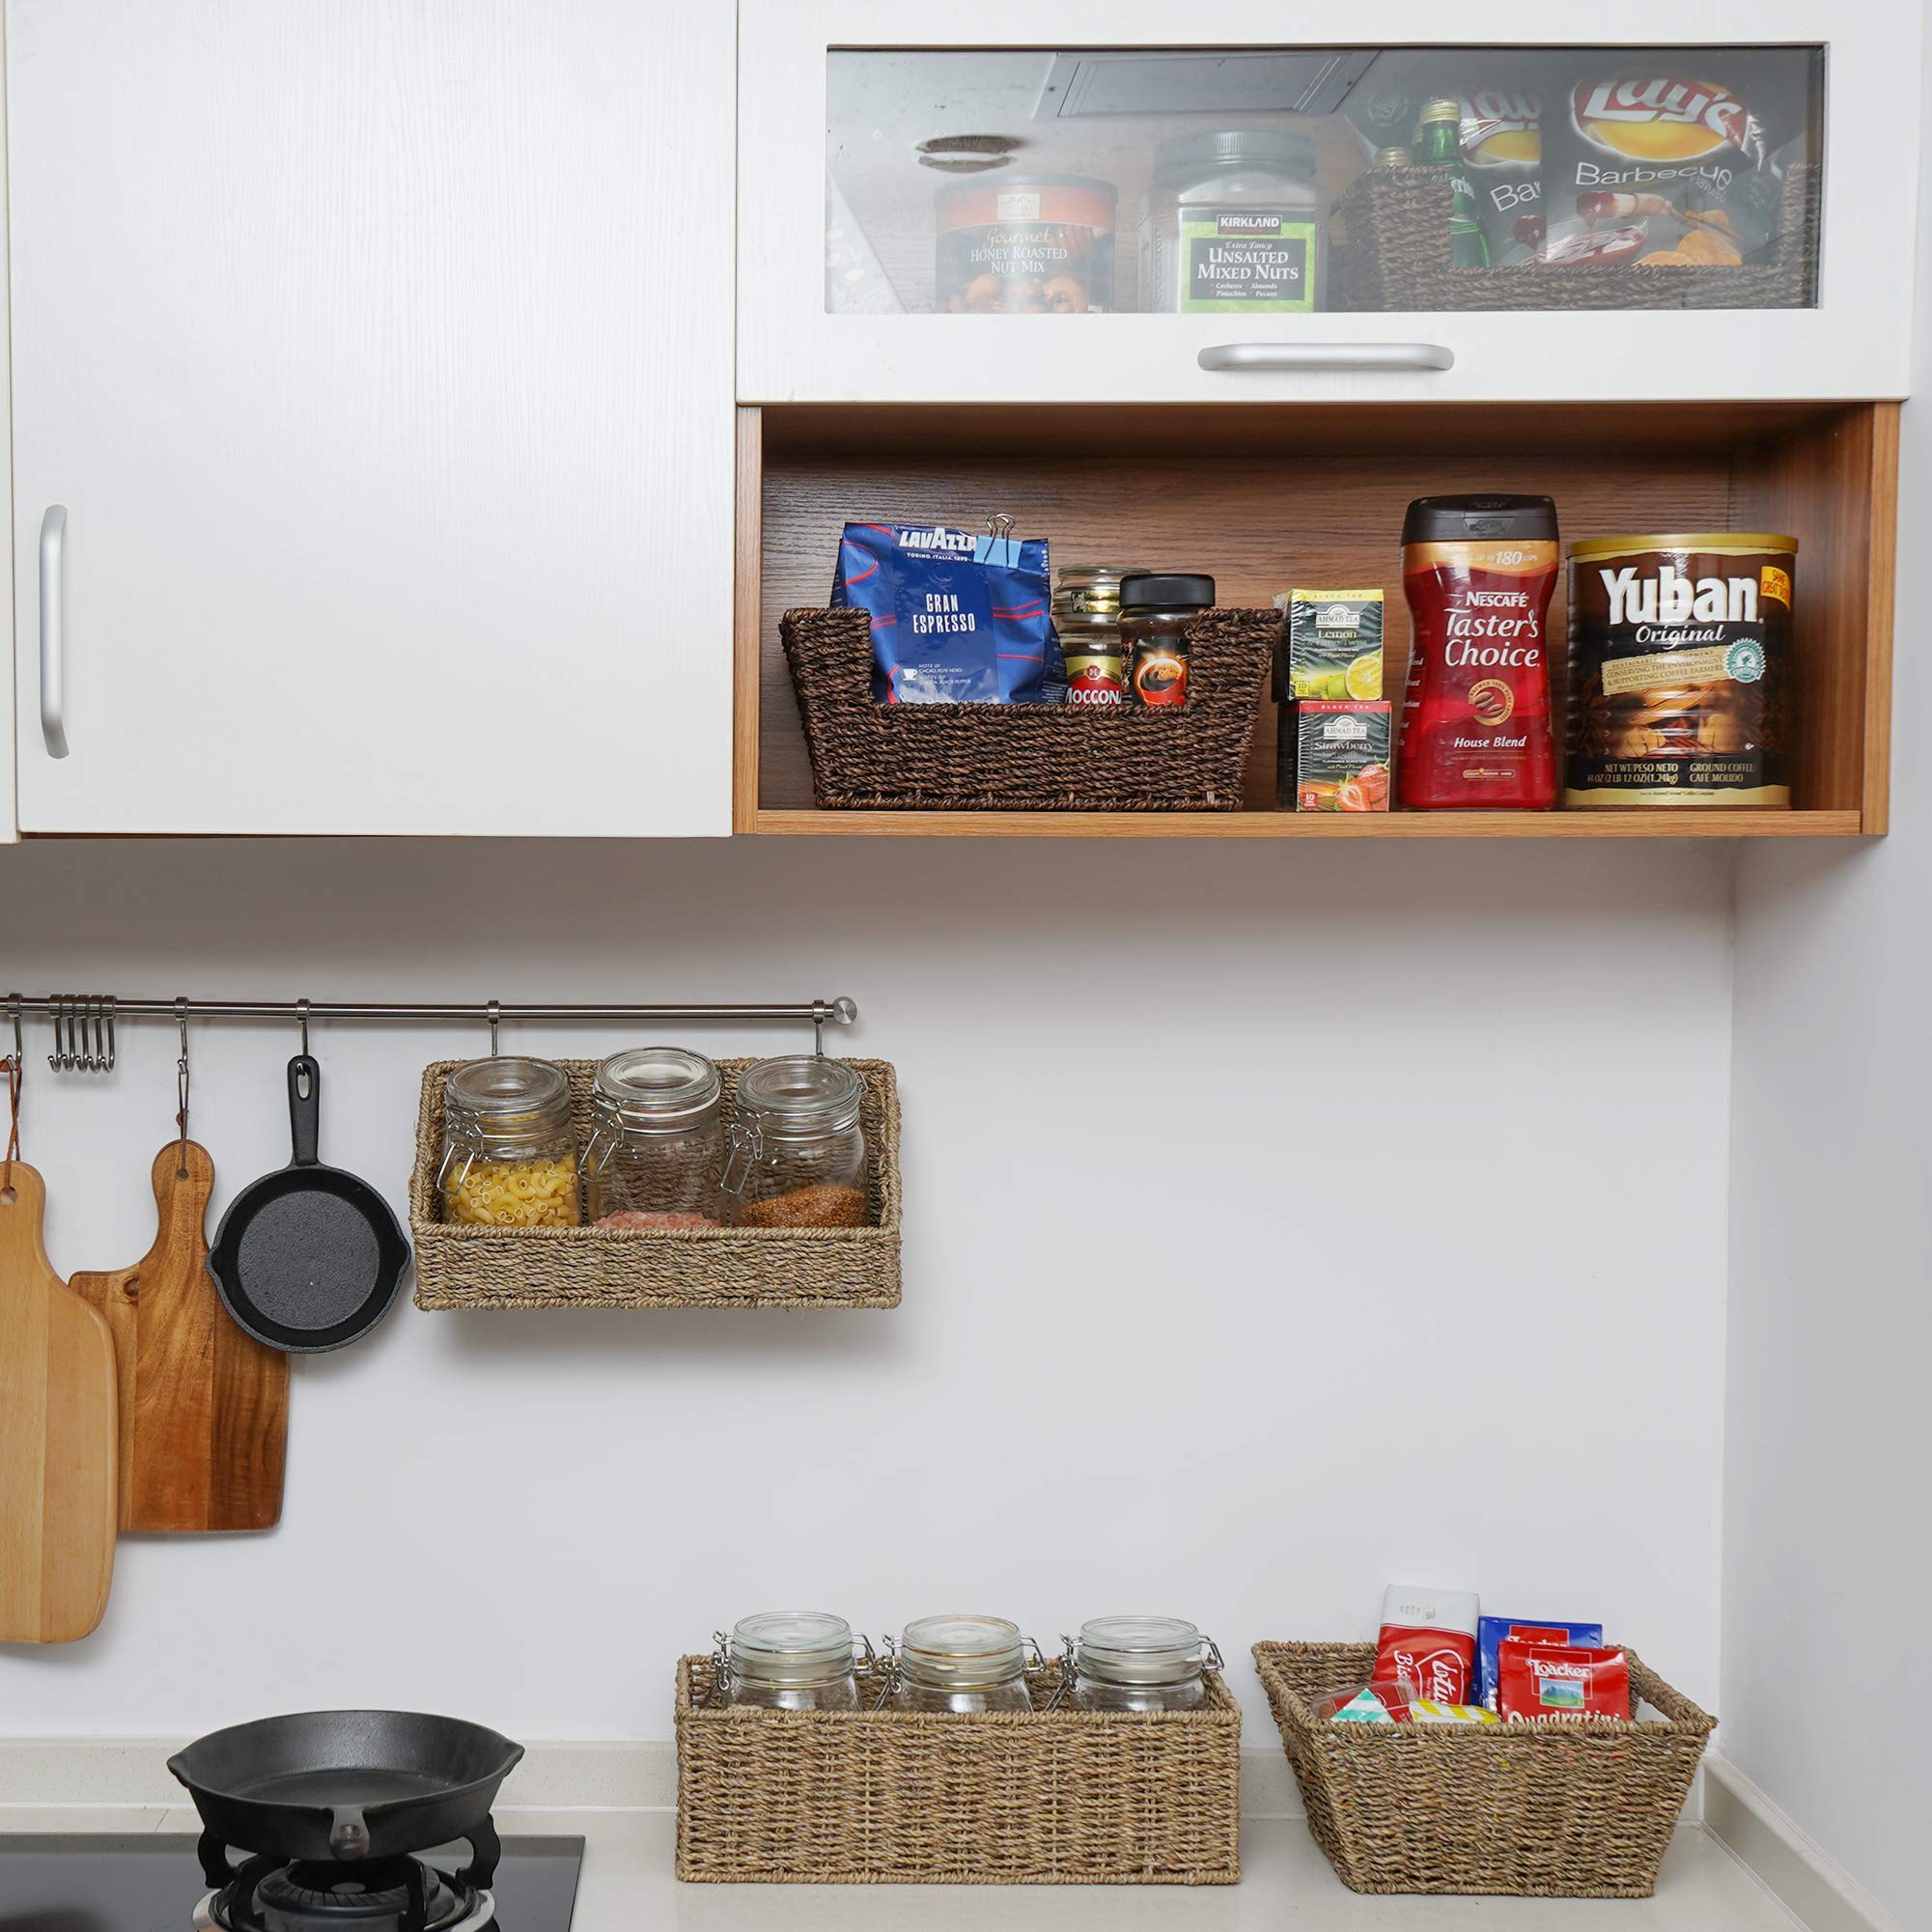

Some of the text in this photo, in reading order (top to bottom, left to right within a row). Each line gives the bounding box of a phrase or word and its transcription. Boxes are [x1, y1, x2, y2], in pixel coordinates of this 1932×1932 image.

[1582, 77, 1741, 138] Lay's
[1575, 161, 1732, 190] Barbecue
[1219, 216, 1279, 228] KIRKLAND
[987, 226, 1051, 248] Gourmet
[970, 246, 1068, 262] HONEY ROASTED
[1209, 247, 1289, 264] UNSALTED
[991, 260, 1045, 274] NUT MIX
[1197, 263, 1299, 280] MIXED NUTS
[899, 527, 977, 552] LAVAZZA
[1496, 550, 1523, 566] 180
[926, 593, 959, 613] GRAN
[1466, 591, 1527, 607] NESCAFÉ
[1599, 565, 1758, 625] Yuban
[912, 613, 975, 634] ESPRESSO
[1317, 615, 1358, 624] AHMAD TEA
[1443, 608, 1539, 638] Taster's
[1318, 630, 1357, 638] Lemon
[1636, 624, 1726, 650] Original
[1444, 638, 1539, 667] Choice
[1065, 687, 1121, 704] MOCCON
[1314, 742, 1374, 752] Strawberry
[1454, 736, 1527, 748] House Blend
[1656, 763, 1679, 771] NETO
[1690, 763, 1726, 772] GROUND
[1526, 1659, 1590, 1678] Loacker
